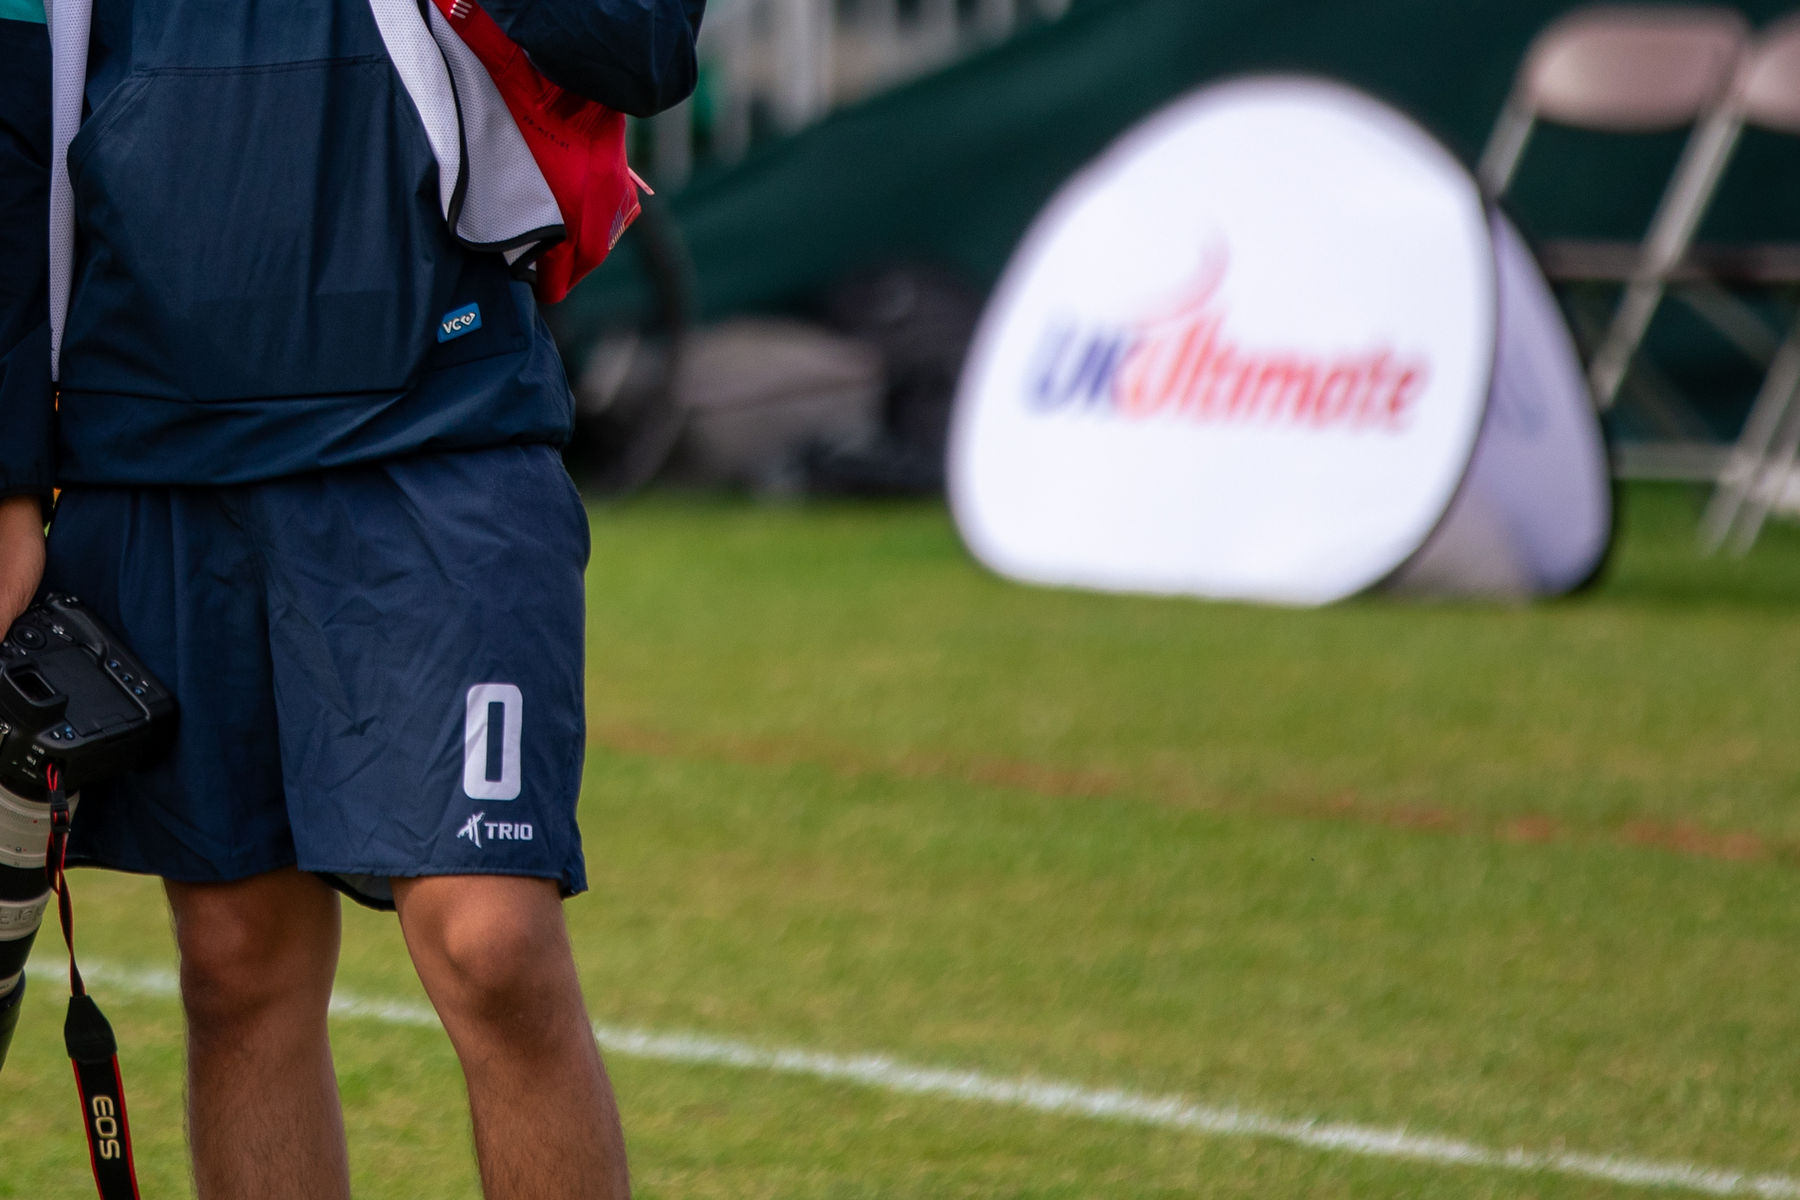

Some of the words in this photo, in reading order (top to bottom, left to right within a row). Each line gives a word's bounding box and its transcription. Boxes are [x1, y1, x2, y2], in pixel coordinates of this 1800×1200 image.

[462, 683, 524, 801] 0
[483, 821, 534, 841] TRIO
[92, 1095, 121, 1161] EOS
